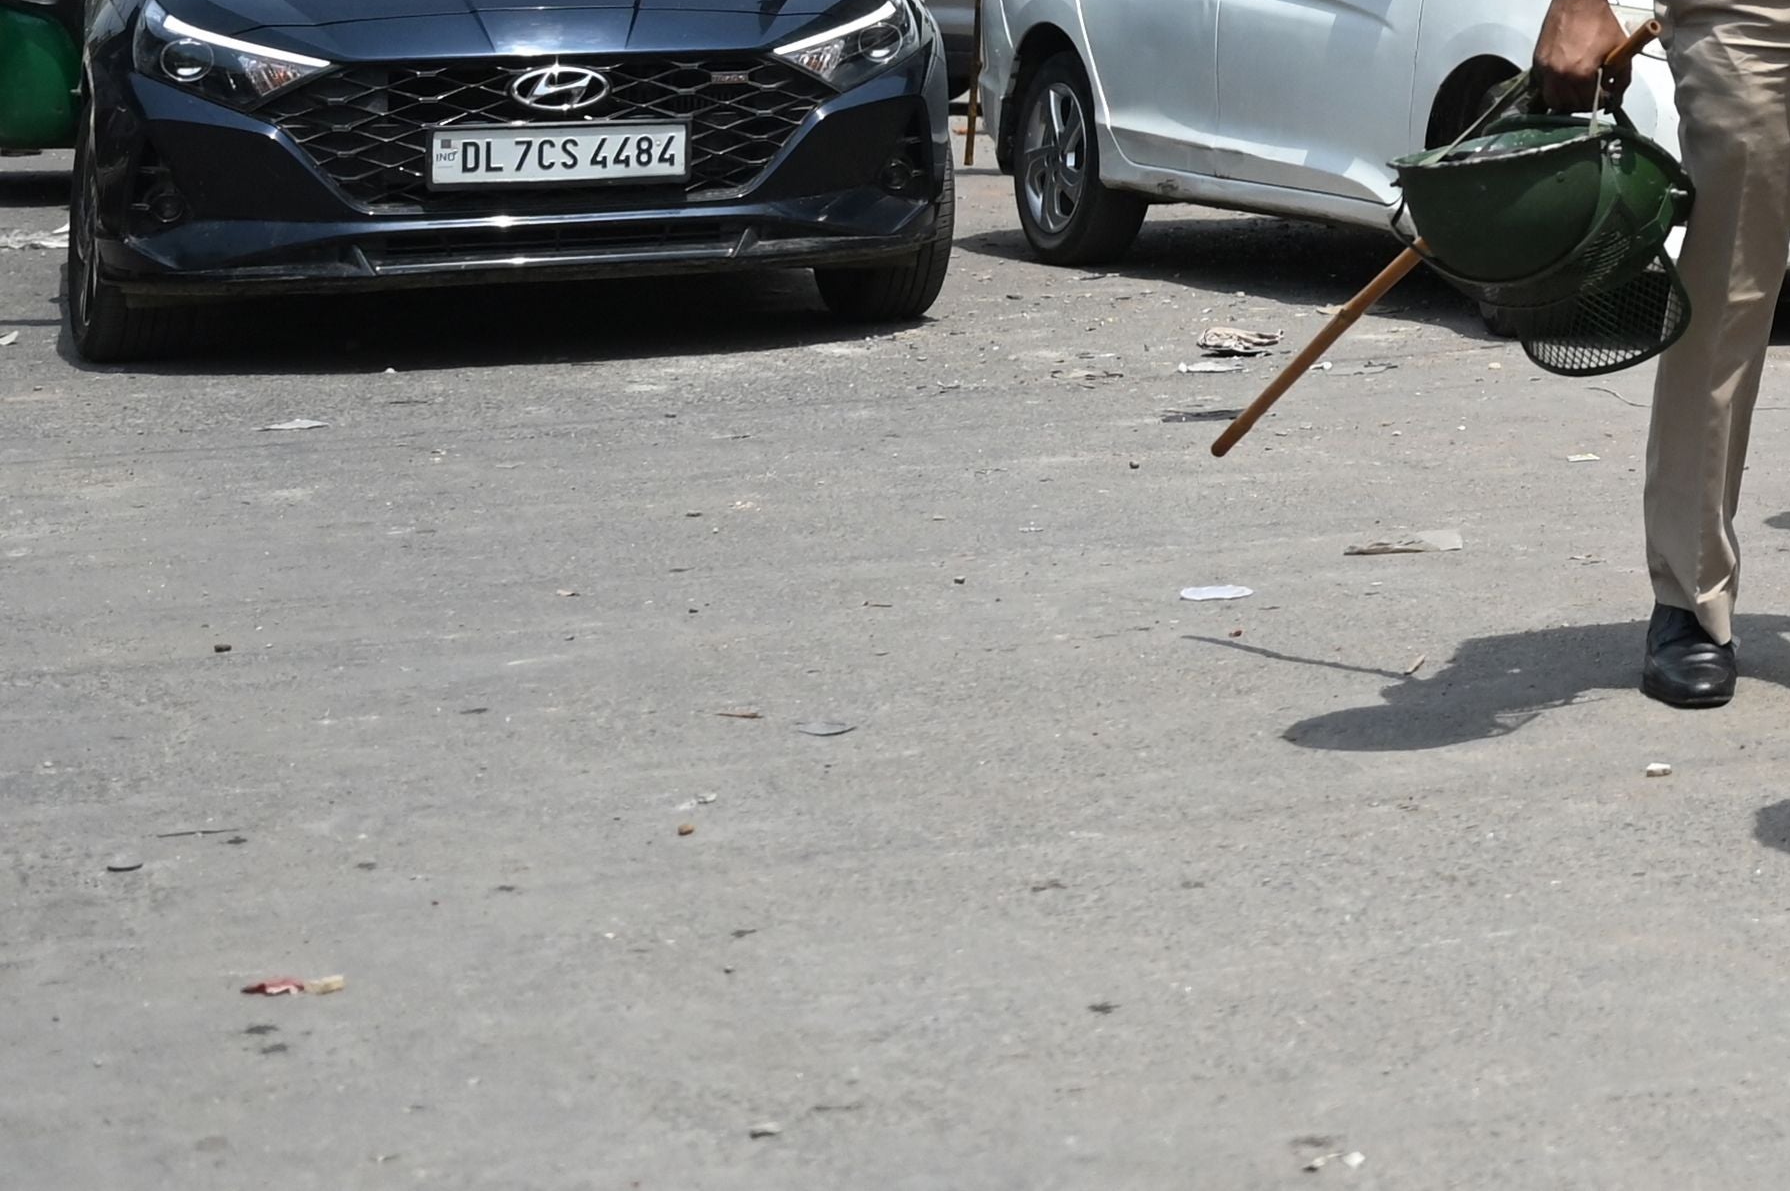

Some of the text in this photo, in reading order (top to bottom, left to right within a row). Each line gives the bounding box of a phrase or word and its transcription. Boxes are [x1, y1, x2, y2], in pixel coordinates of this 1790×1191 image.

[461, 134, 676, 174] DL 7CS 4484
